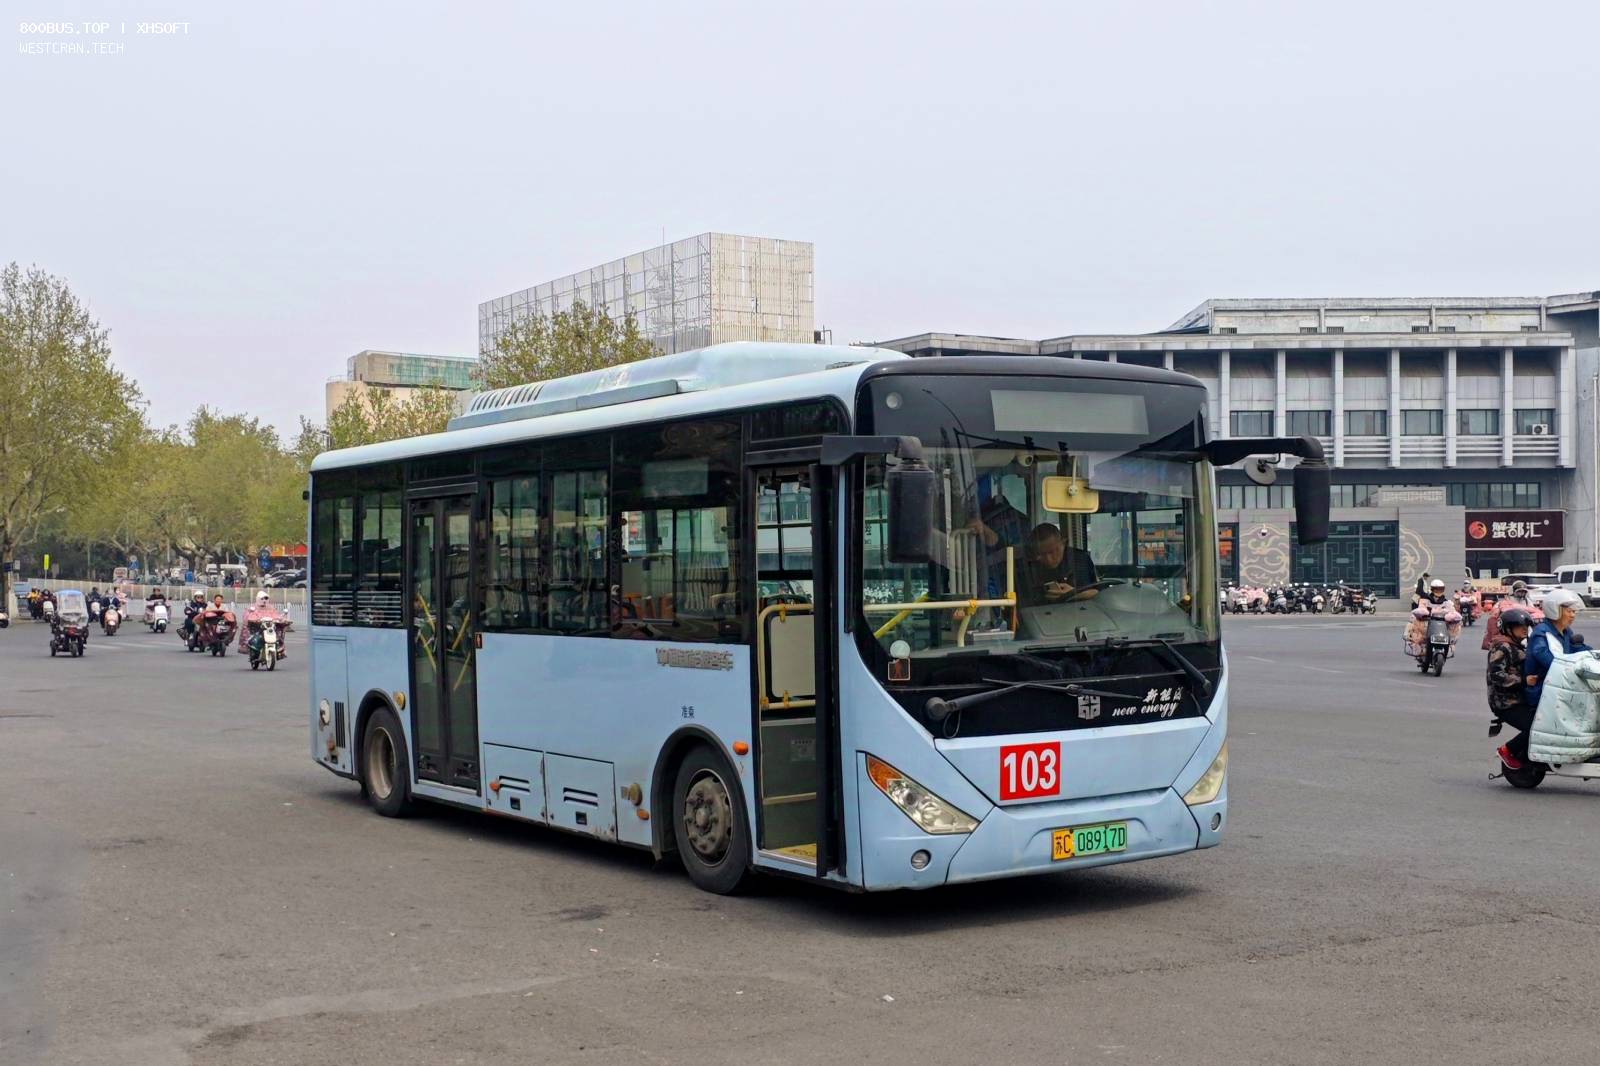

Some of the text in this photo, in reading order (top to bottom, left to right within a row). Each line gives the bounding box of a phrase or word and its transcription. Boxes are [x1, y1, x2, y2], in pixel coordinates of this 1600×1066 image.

[1492, 521, 1542, 539] 蟹都汇
[1111, 702, 1179, 718] new energy
[1003, 748, 1057, 793] 103
[1077, 827, 1126, 852] 08917D
